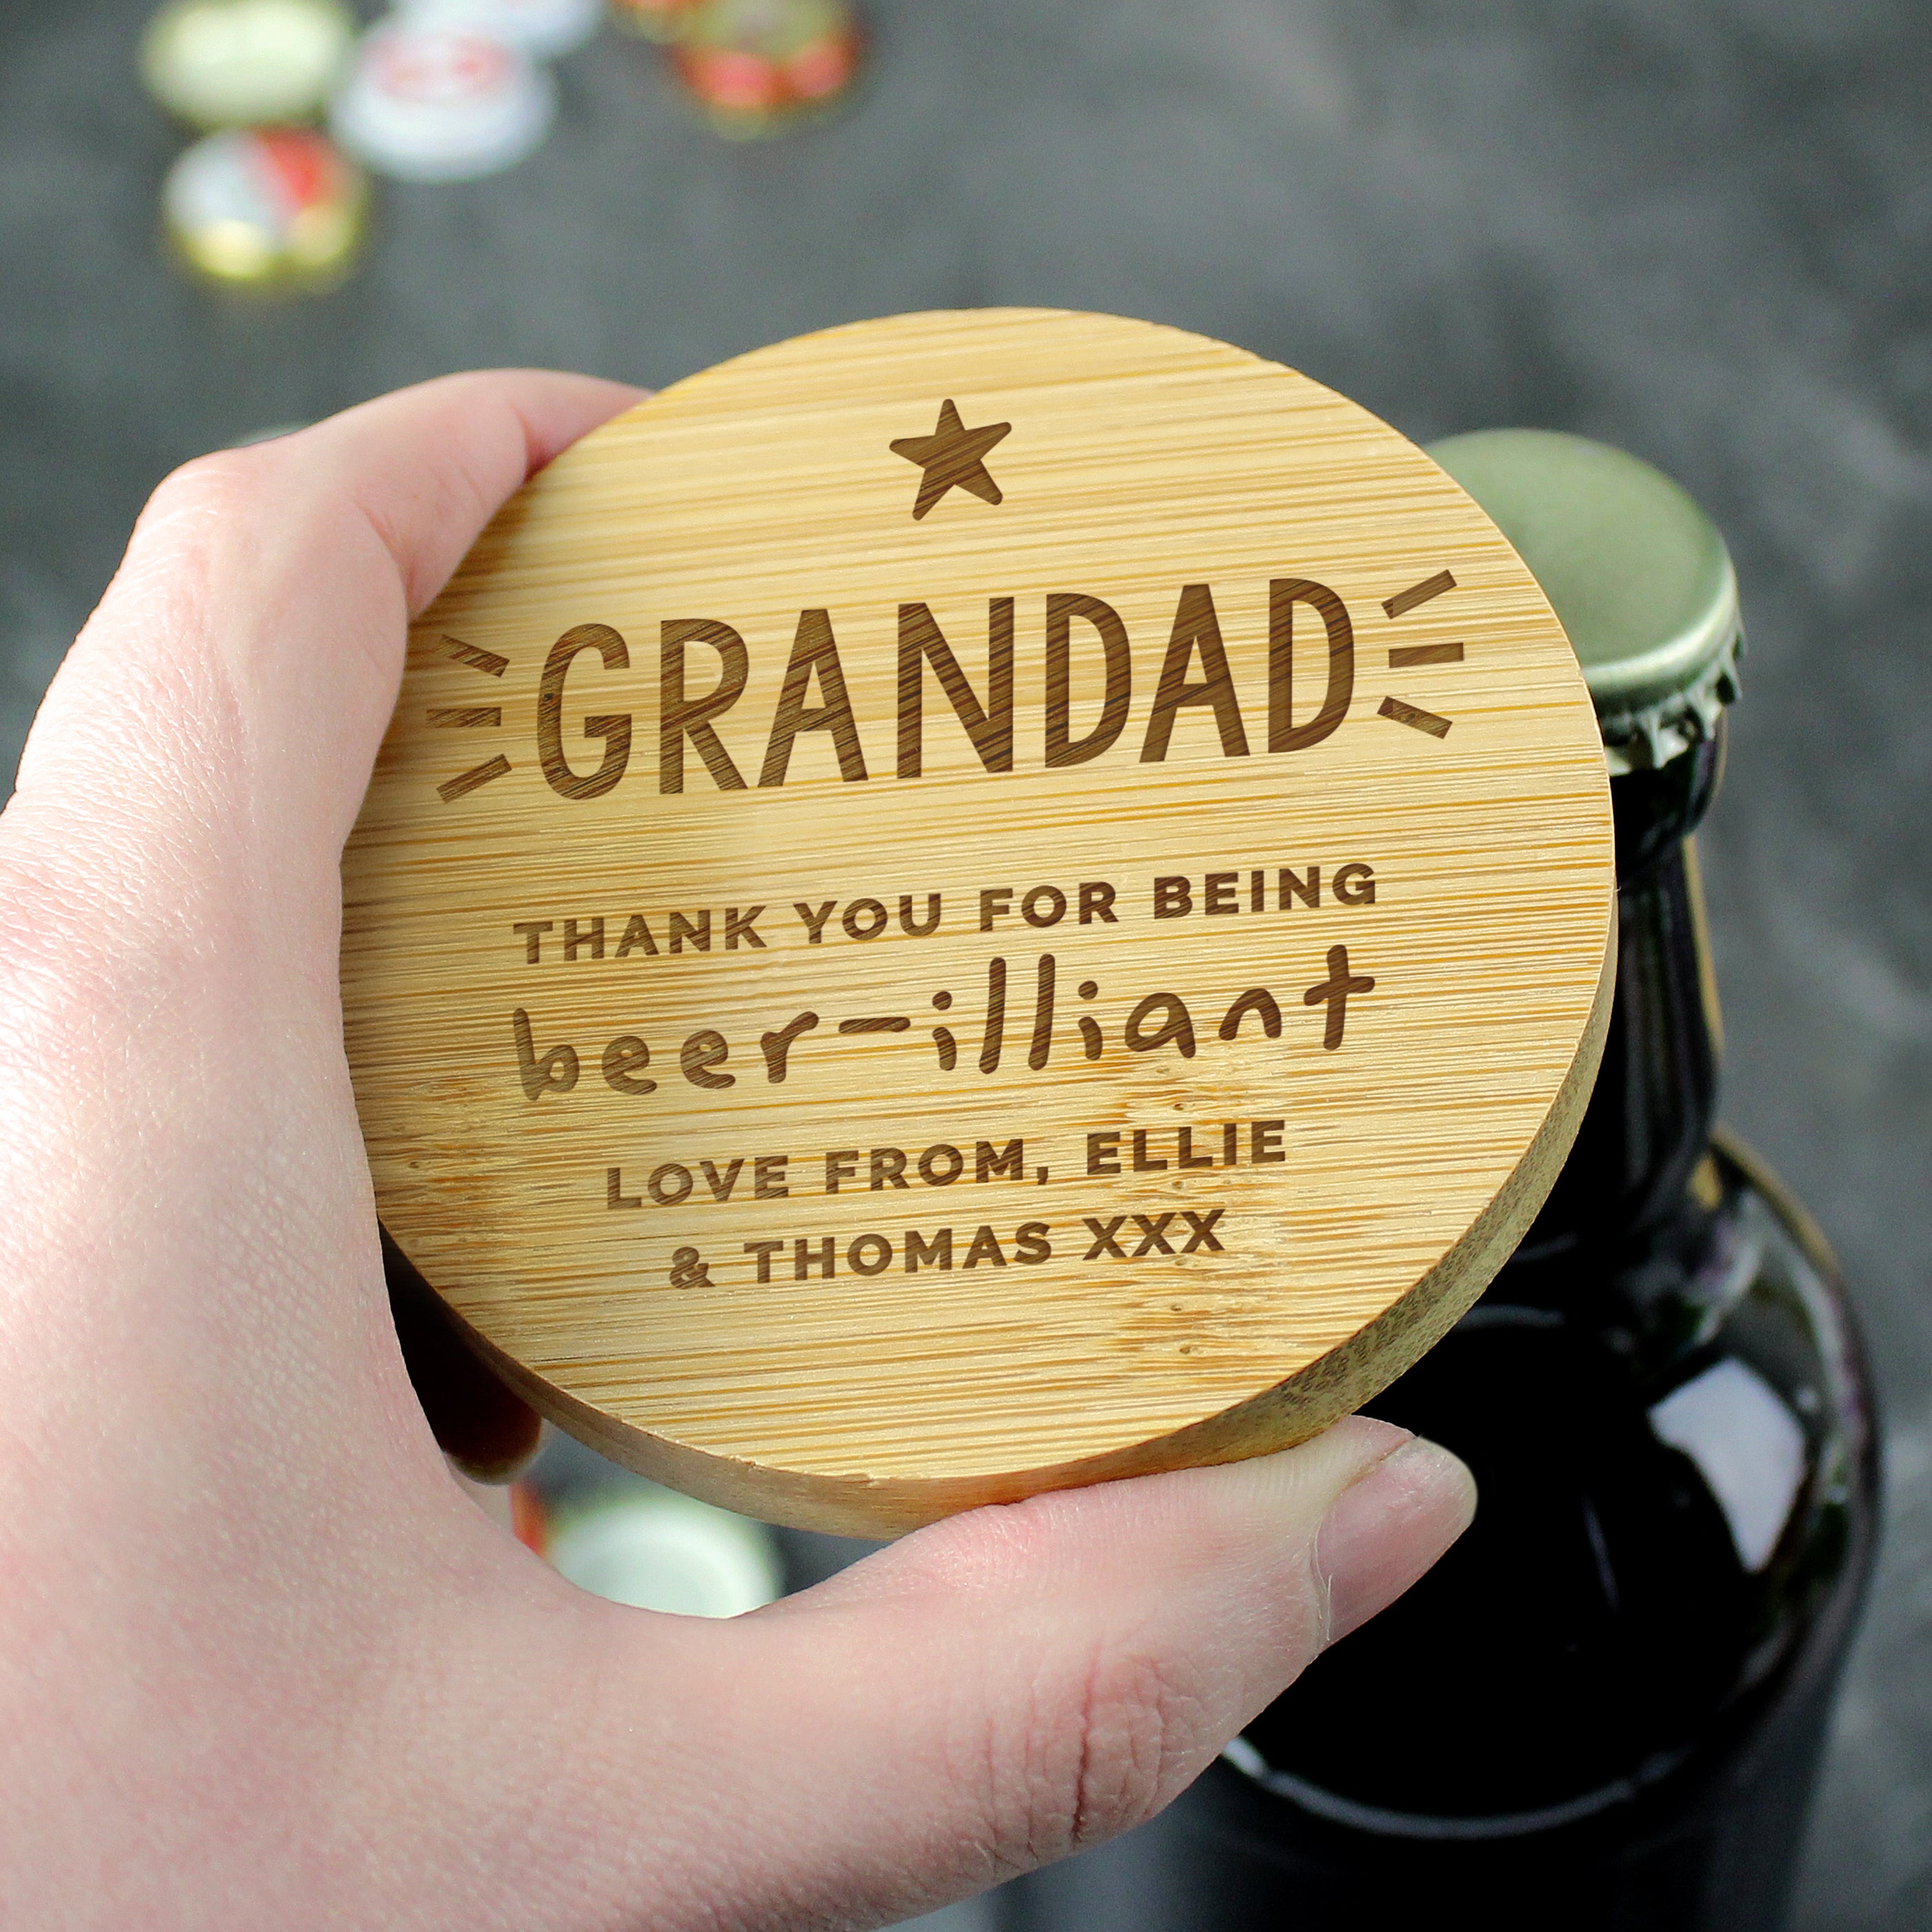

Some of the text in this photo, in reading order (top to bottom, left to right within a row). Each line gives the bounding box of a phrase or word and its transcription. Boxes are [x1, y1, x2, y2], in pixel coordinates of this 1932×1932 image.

[539, 578, 1354, 800] GRANDAD
[513, 862, 1376, 963] THANK YOU FOR BEING
[513, 944, 1374, 1102] beer-illiant
[607, 1120, 1285, 1210] LOVE FROM, ELLIE
[670, 1208, 1225, 1289] & THOMAS XXX
